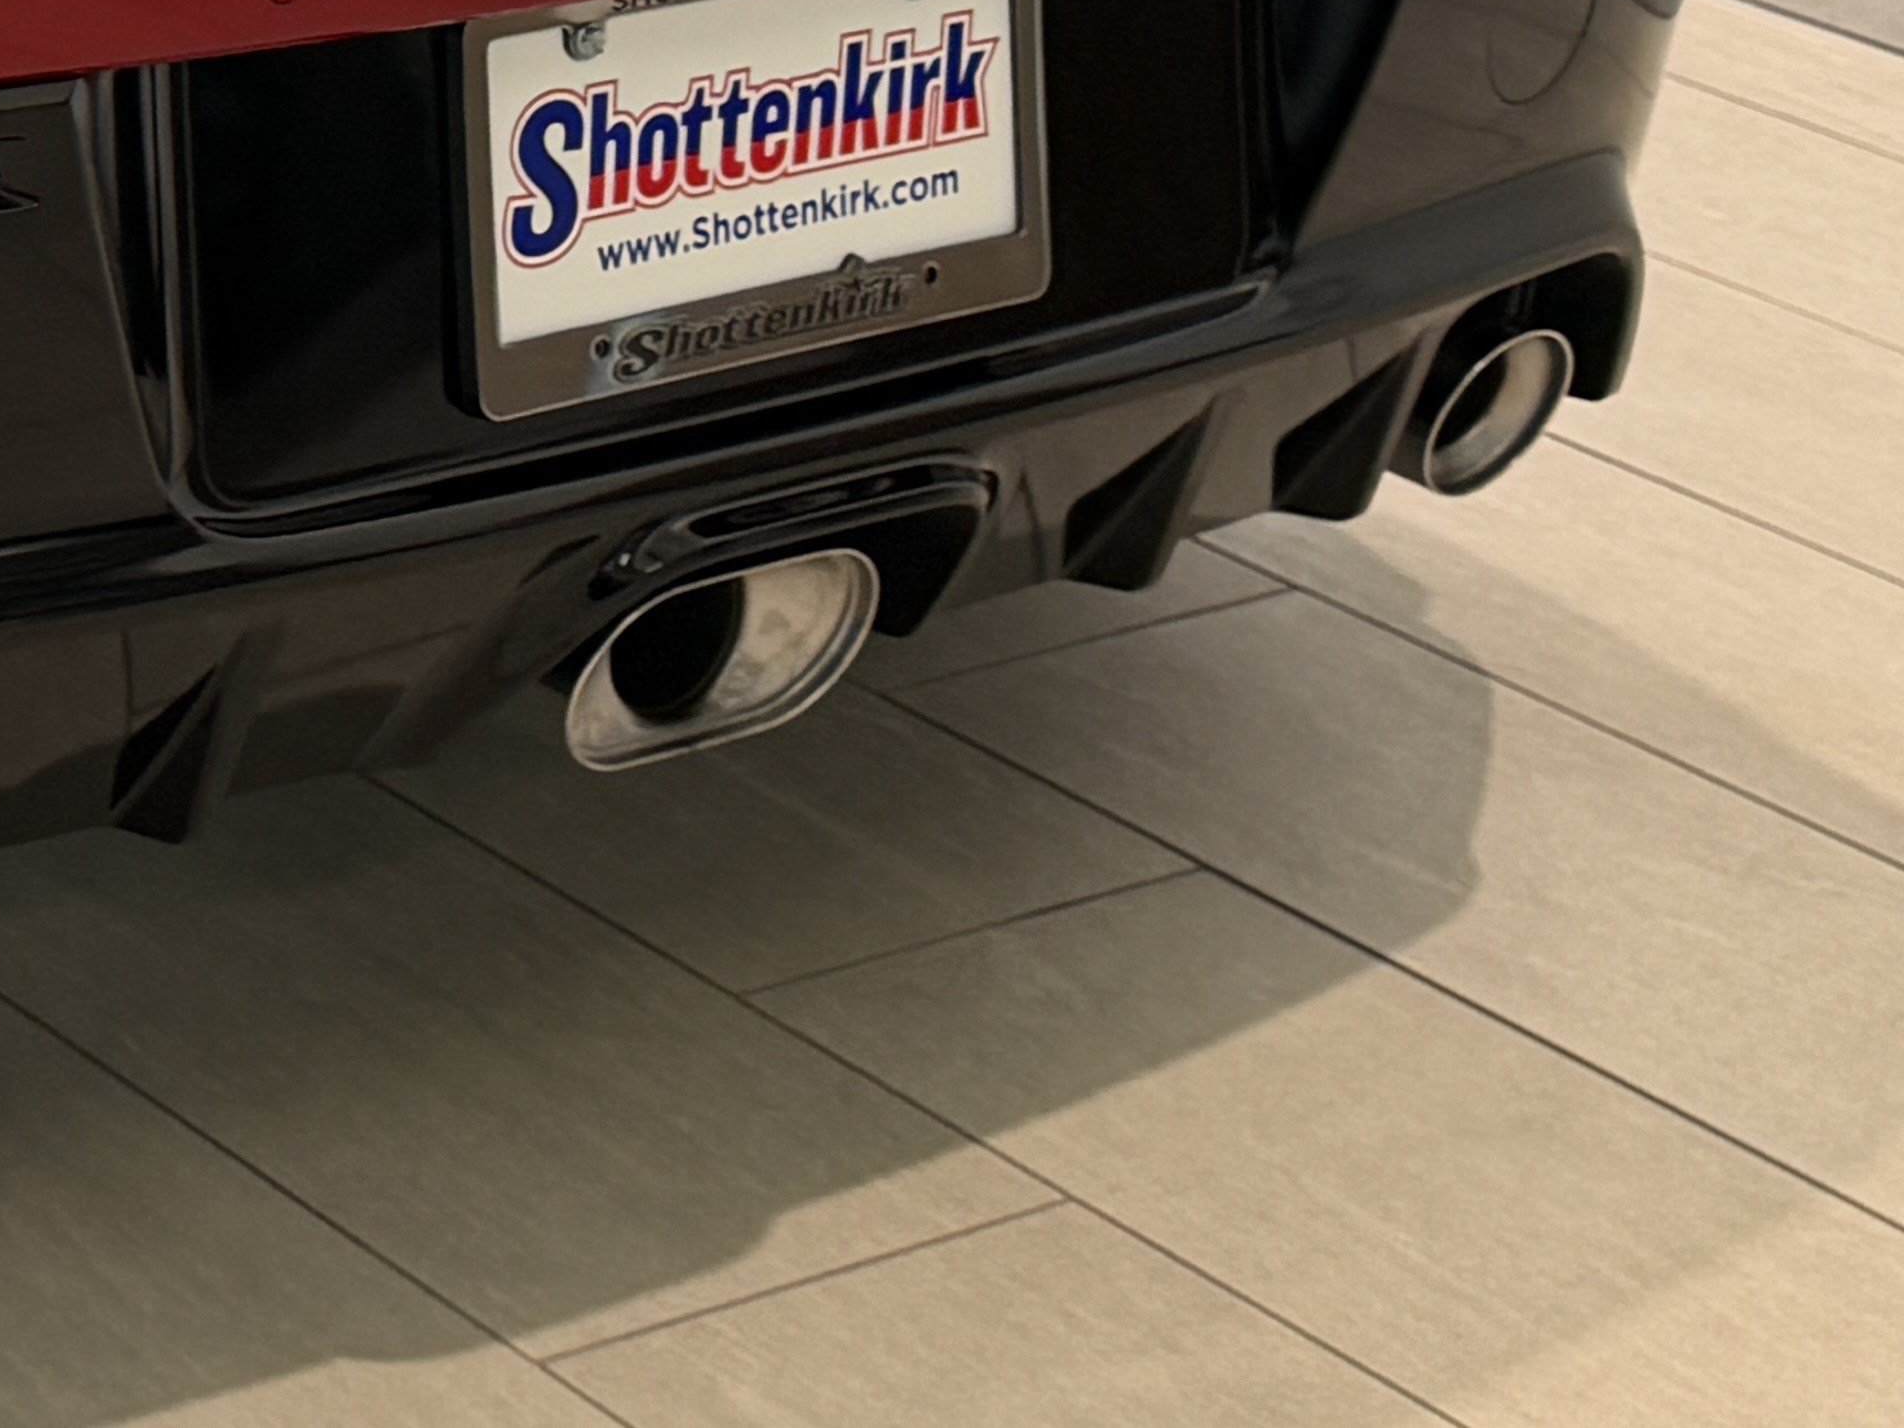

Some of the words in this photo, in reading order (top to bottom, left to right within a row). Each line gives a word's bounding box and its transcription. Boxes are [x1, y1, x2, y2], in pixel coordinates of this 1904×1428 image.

[502, 10, 999, 269] Shottenkirk
[596, 169, 959, 270] www.Shottenkirk.com
[613, 276, 910, 380] Shottenkirk
